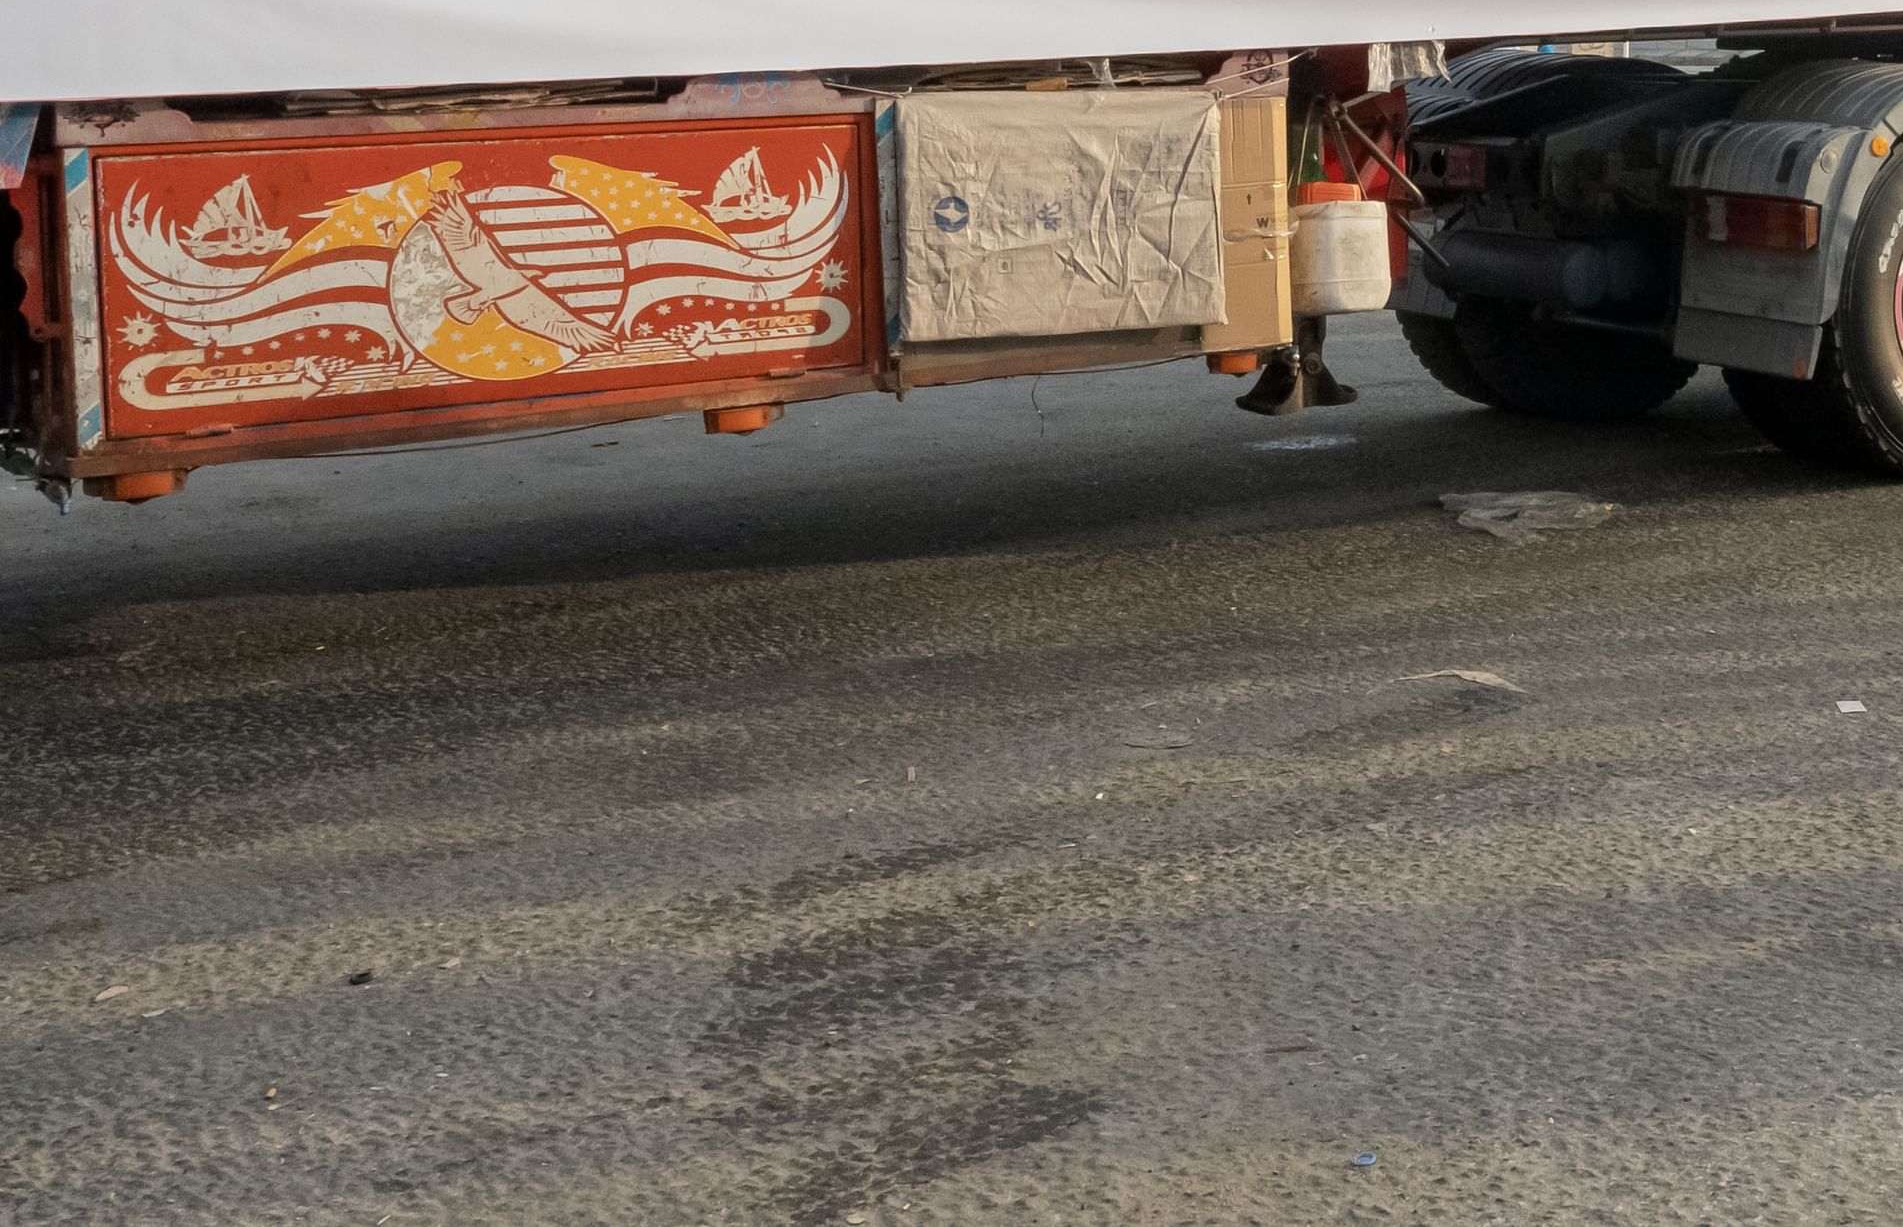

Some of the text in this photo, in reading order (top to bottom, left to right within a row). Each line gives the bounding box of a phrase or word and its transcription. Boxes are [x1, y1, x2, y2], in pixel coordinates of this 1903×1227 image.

[715, 313, 813, 333] ACTROS
[171, 358, 296, 382] ACTROS
[176, 374, 285, 391] SPORT
